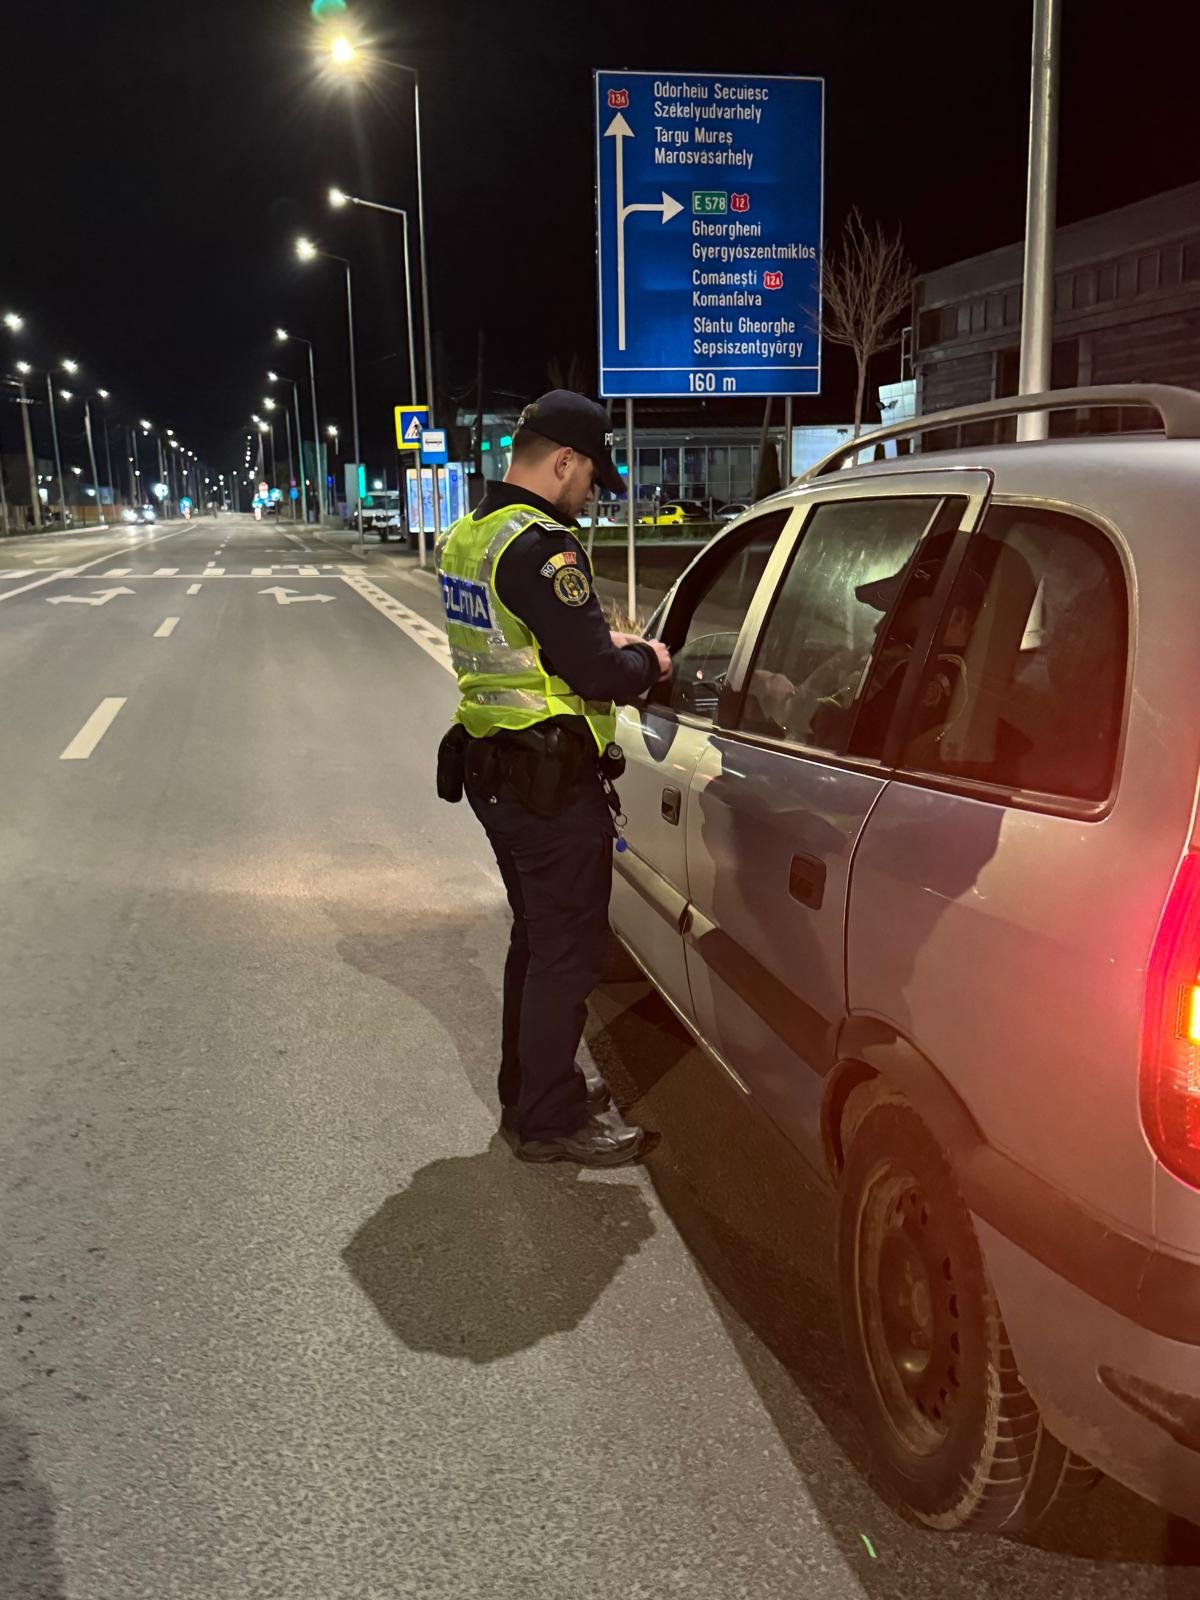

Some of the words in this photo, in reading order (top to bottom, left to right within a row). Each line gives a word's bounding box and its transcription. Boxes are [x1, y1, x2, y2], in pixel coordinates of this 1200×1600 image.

[611, 93, 626, 105] 13A
[654, 81, 708, 98] Odorheiu
[714, 83, 769, 100] Secuiesc
[654, 101, 762, 124] Székelyudvarhely
[654, 126, 689, 146] Târgu
[654, 147, 753, 170] Marosvásárhely
[694, 195, 702, 210] E
[705, 196, 726, 211] 578
[735, 197, 745, 208] 12
[692, 220, 761, 240] Gheorgheni
[692, 242, 816, 262] Gyergyószentmiklós
[766, 276, 781, 286] 12A
[692, 291, 762, 307] Kománfalva
[693, 317, 733, 333] Sfântu
[738, 317, 795, 336] Gheorghe
[693, 339, 803, 358] Sepsiszentgyörgy
[688, 373, 716, 391] 160
[722, 377, 736, 391] m
